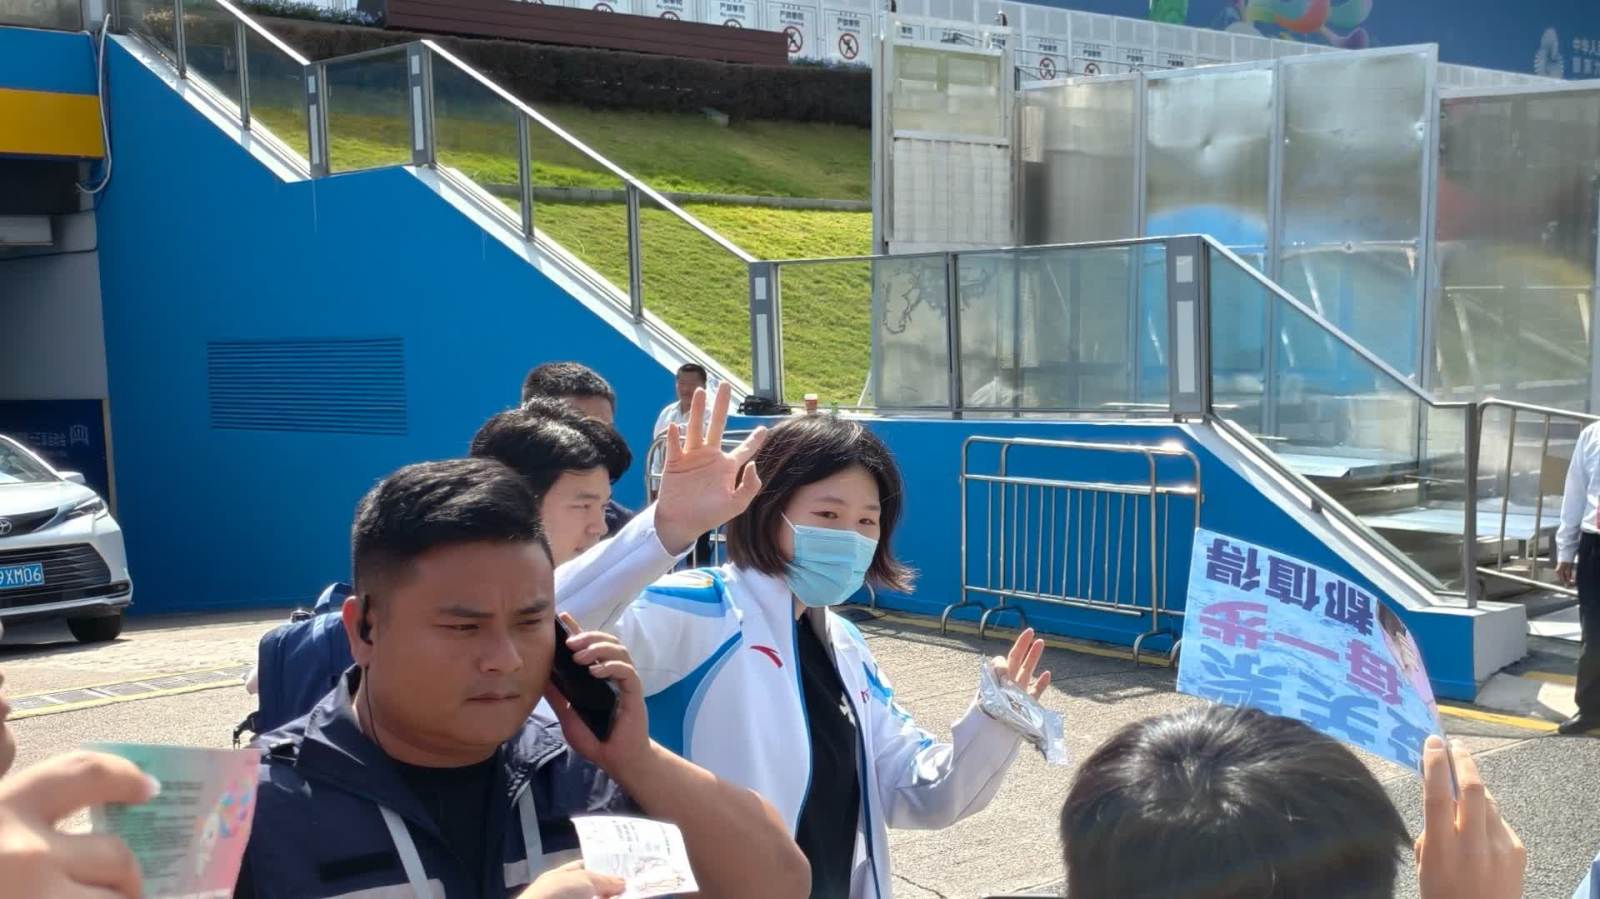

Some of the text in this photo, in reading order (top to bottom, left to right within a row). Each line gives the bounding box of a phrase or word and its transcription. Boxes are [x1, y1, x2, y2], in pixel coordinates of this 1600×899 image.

[1205, 537, 1374, 636] 都值得
[1198, 600, 1403, 705] 每一步
